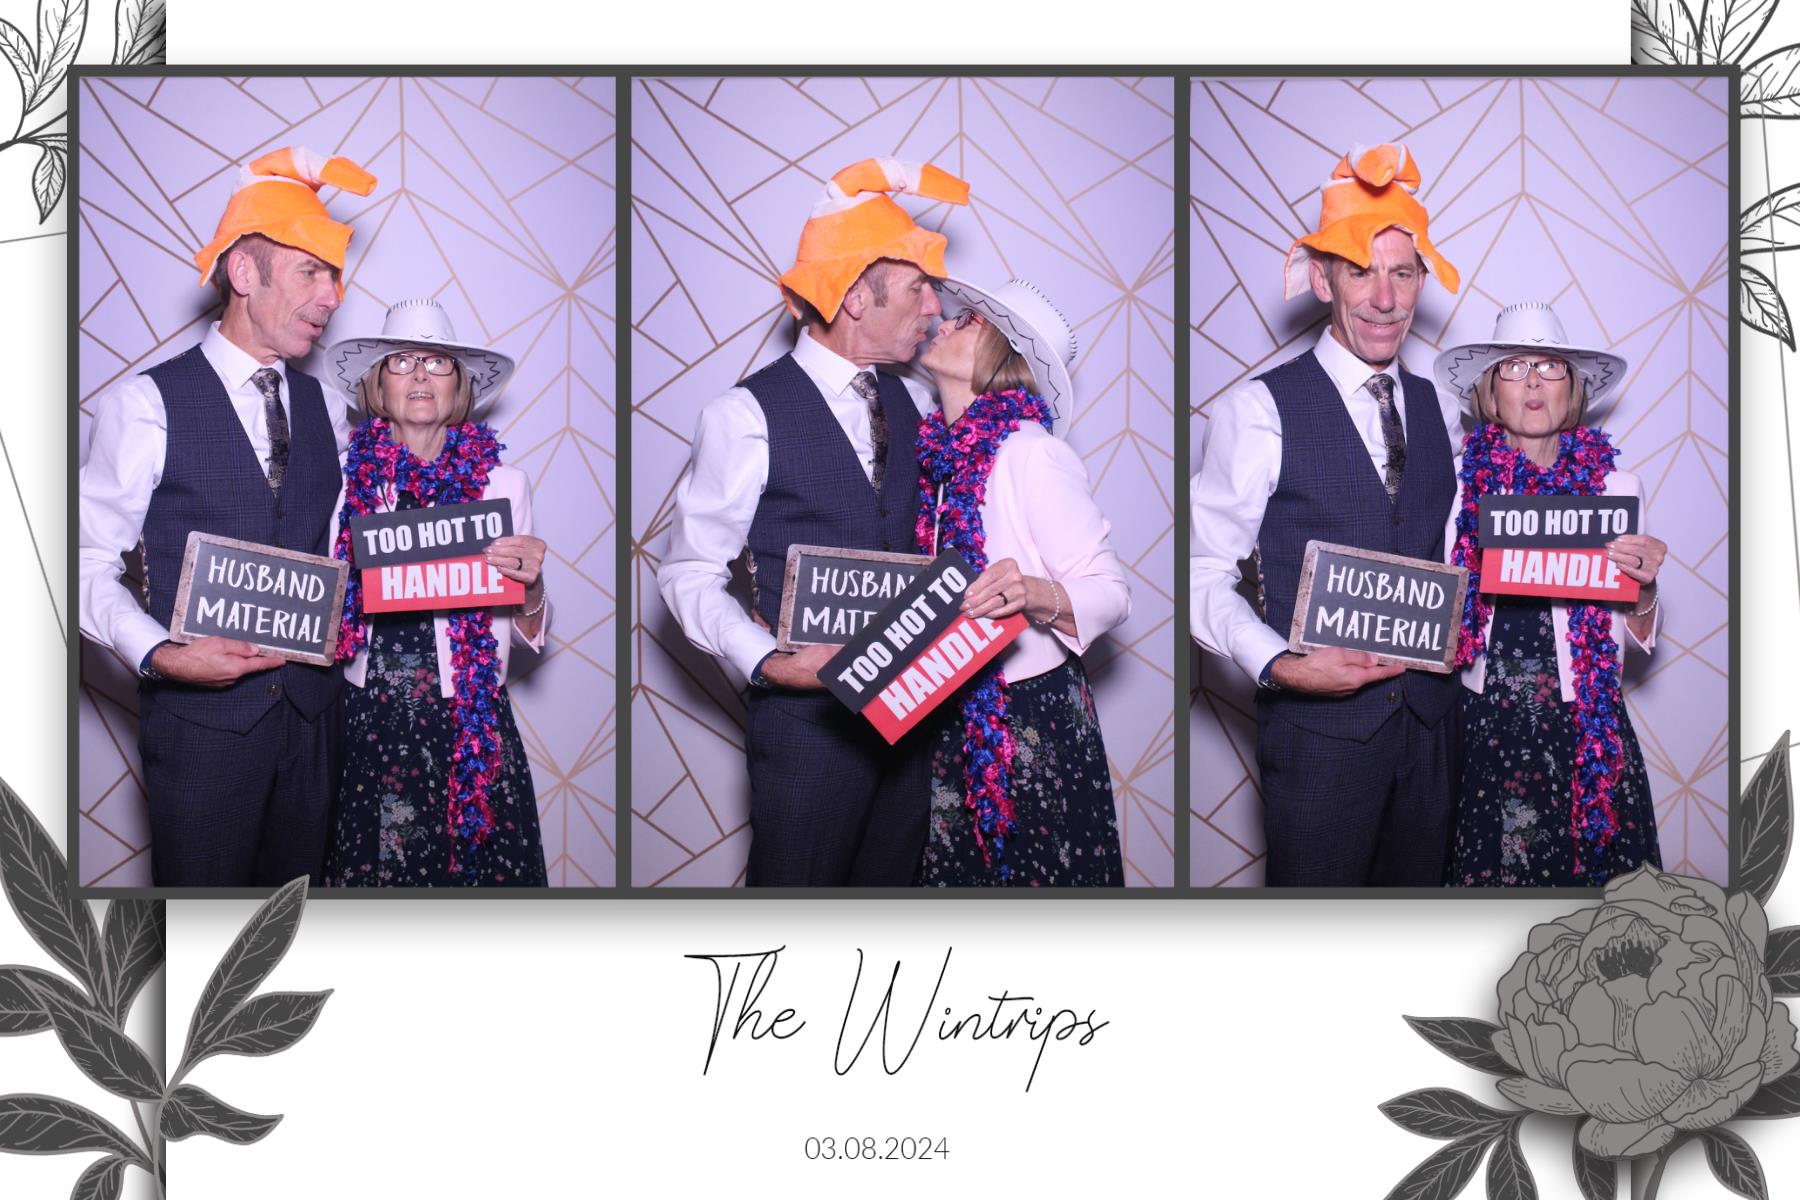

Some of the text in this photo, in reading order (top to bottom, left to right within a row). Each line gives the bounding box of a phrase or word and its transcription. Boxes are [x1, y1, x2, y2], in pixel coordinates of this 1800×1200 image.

[363, 511, 503, 556] TOO HOT TO
[1490, 508, 1628, 537] TOO HOT TO
[207, 555, 325, 603] HUSBAND
[381, 562, 504, 600] HANDLE
[811, 566, 916, 599] HUSBAN
[1326, 563, 1445, 610] HUSBAND
[1500, 549, 1621, 589] HANDLE
[196, 596, 323, 644] MATERIAL
[837, 566, 968, 694] TOO HOT TO
[1316, 606, 1443, 651] MATERIAL
[878, 617, 1005, 721] HANDLE
